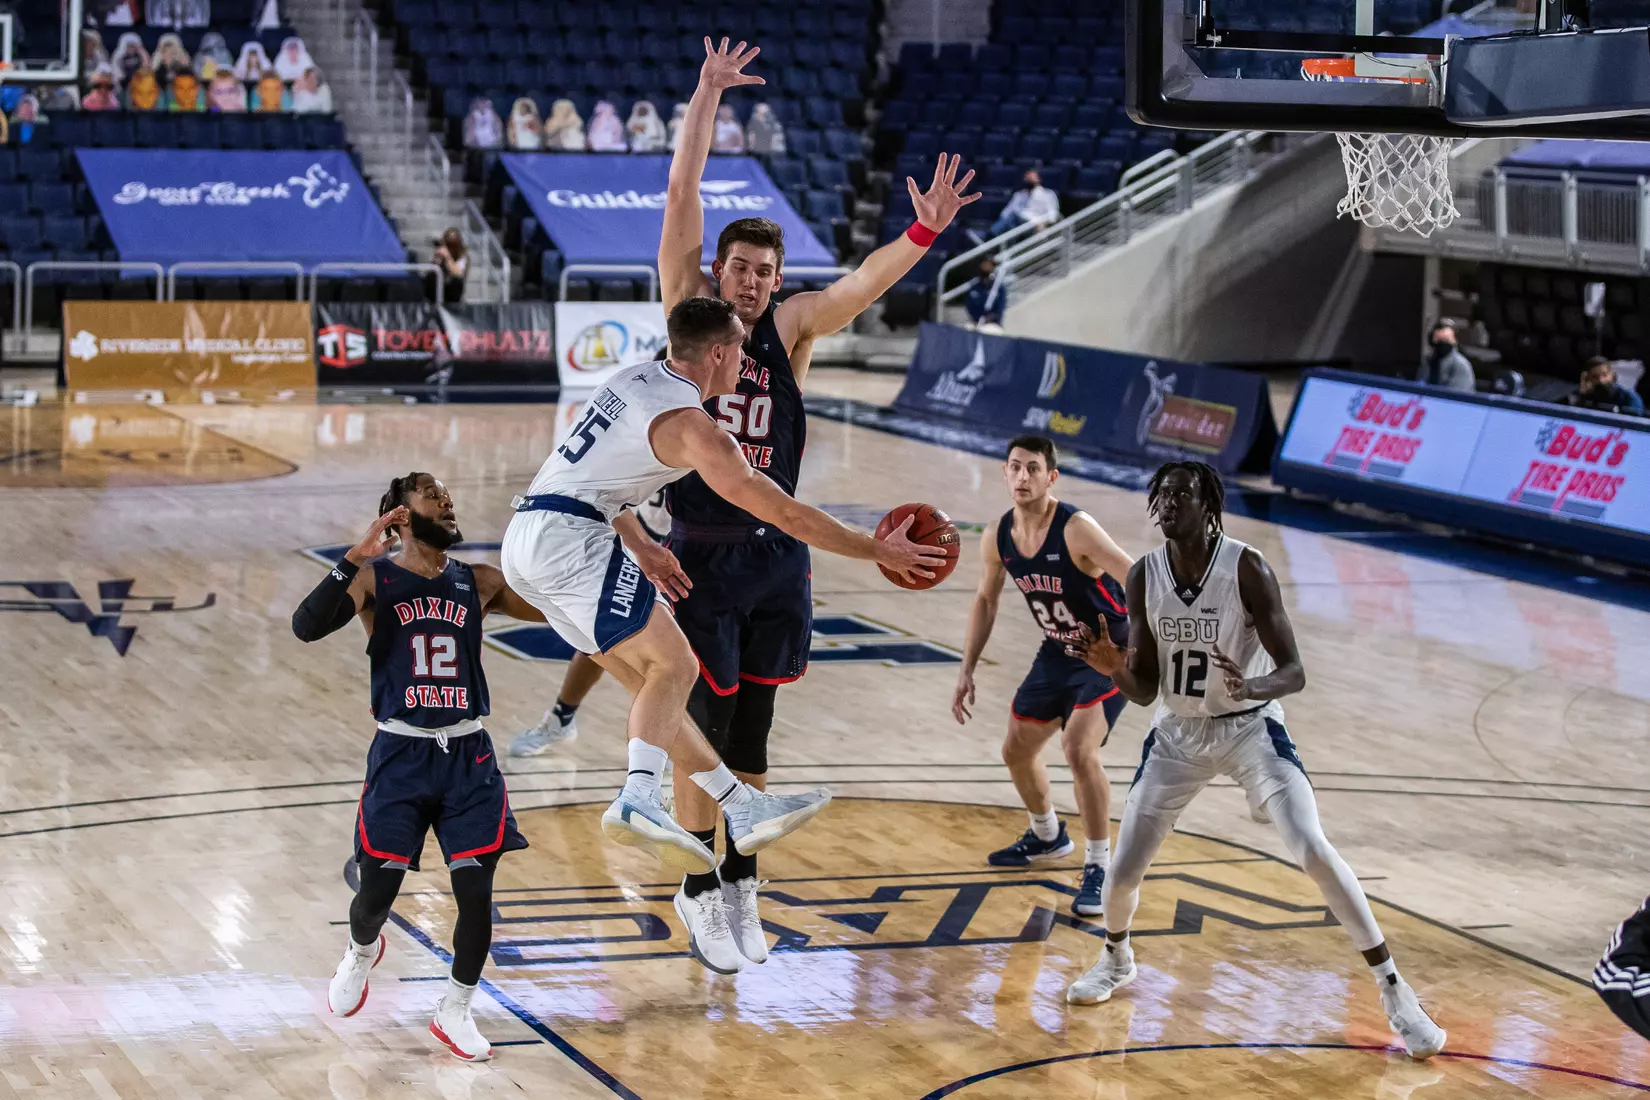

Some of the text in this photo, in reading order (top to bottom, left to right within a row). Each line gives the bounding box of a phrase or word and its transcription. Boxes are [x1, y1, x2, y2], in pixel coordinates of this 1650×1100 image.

[716, 391, 773, 439] 50
[1546, 425, 1630, 467] Bud's
[1510, 460, 1625, 511] TIRE PROS
[1015, 573, 1063, 594] DIXIE
[393, 597, 468, 628] DIXIE
[1031, 600, 1077, 630] 24
[1159, 617, 1219, 643] CBU
[410, 633, 458, 679] 12
[1172, 649, 1208, 698] 12
[404, 685, 469, 709] STATE
